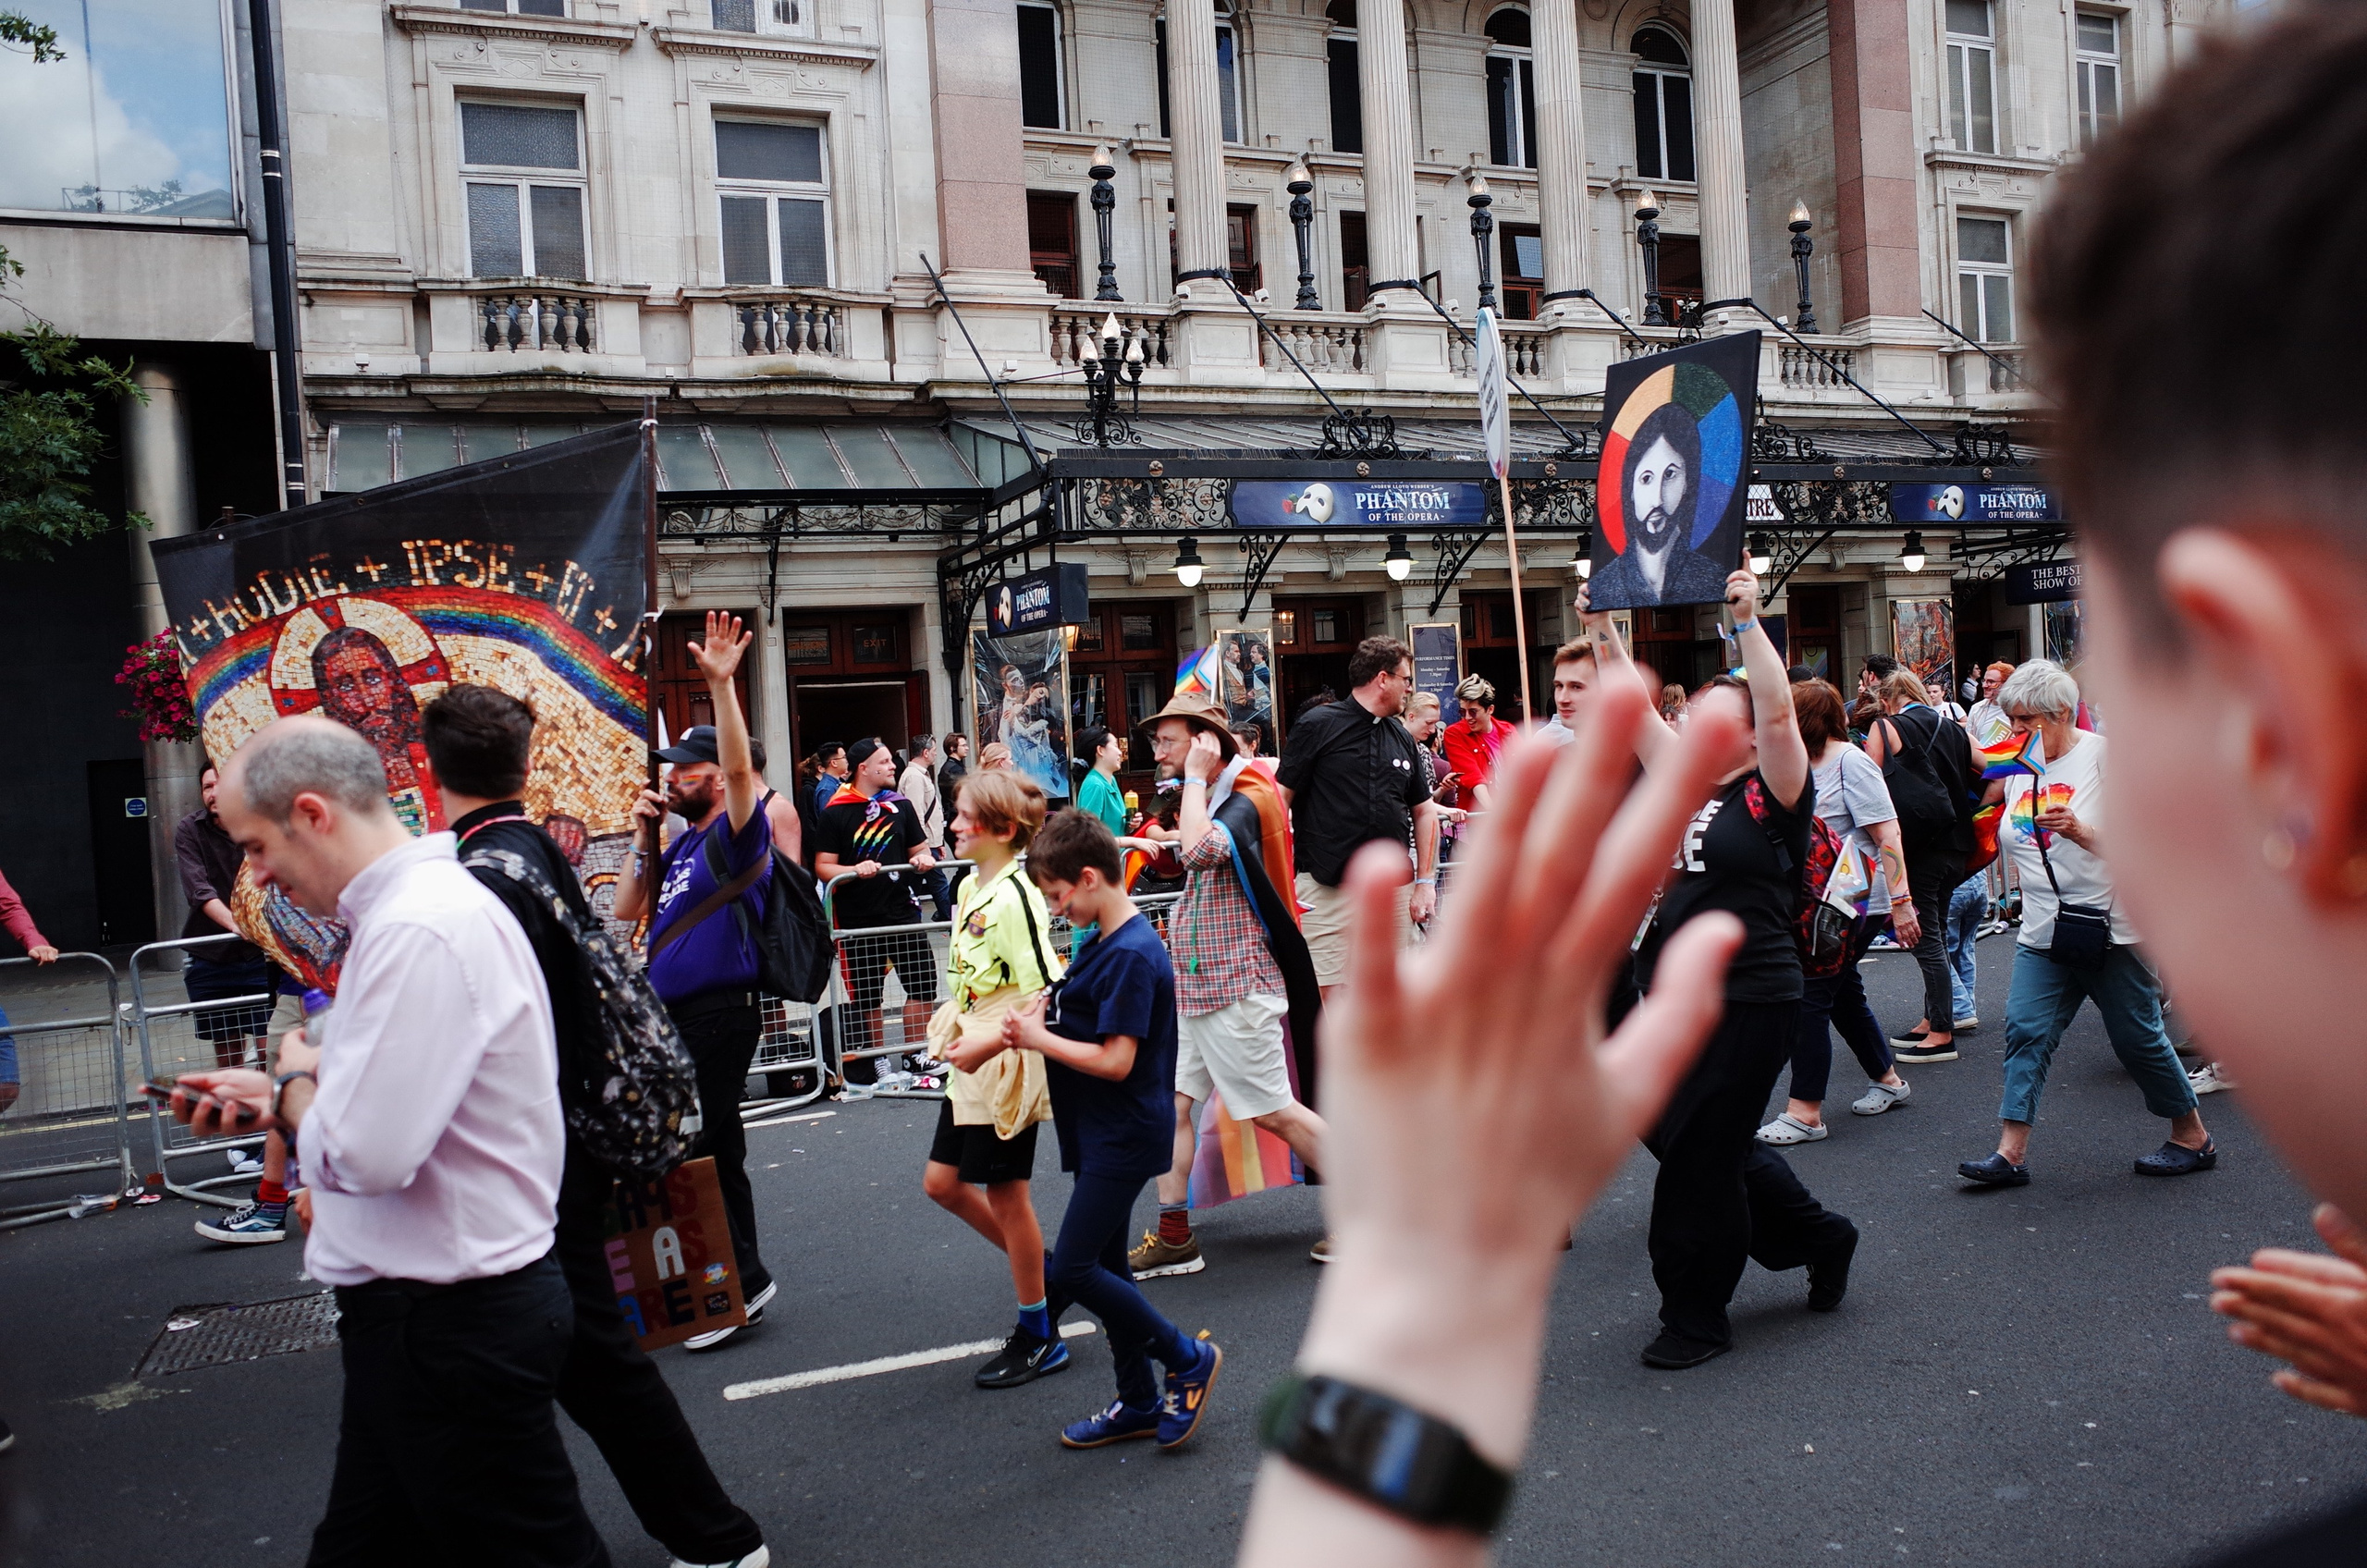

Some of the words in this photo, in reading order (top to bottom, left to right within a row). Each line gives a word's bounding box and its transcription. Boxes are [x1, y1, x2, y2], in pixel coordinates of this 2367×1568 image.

[1355, 491, 1451, 510] PHANTOM
[1747, 498, 1774, 516] TRE
[1979, 493, 2048, 509] PHANTOM
[1368, 513, 1383, 521] OF
[1385, 513, 1404, 521] THE
[1407, 512, 1440, 521] OPERA
[2016, 510, 2040, 519] OPERA
[401, 539, 516, 594] IPSE
[2031, 568, 2054, 580] THE
[2056, 564, 2082, 577] BEST
[2033, 576, 2066, 591] SHOW
[2067, 575, 2083, 586] OF
[1015, 585, 1050, 612] PHANTOM
[1021, 615, 1026, 623] OF
